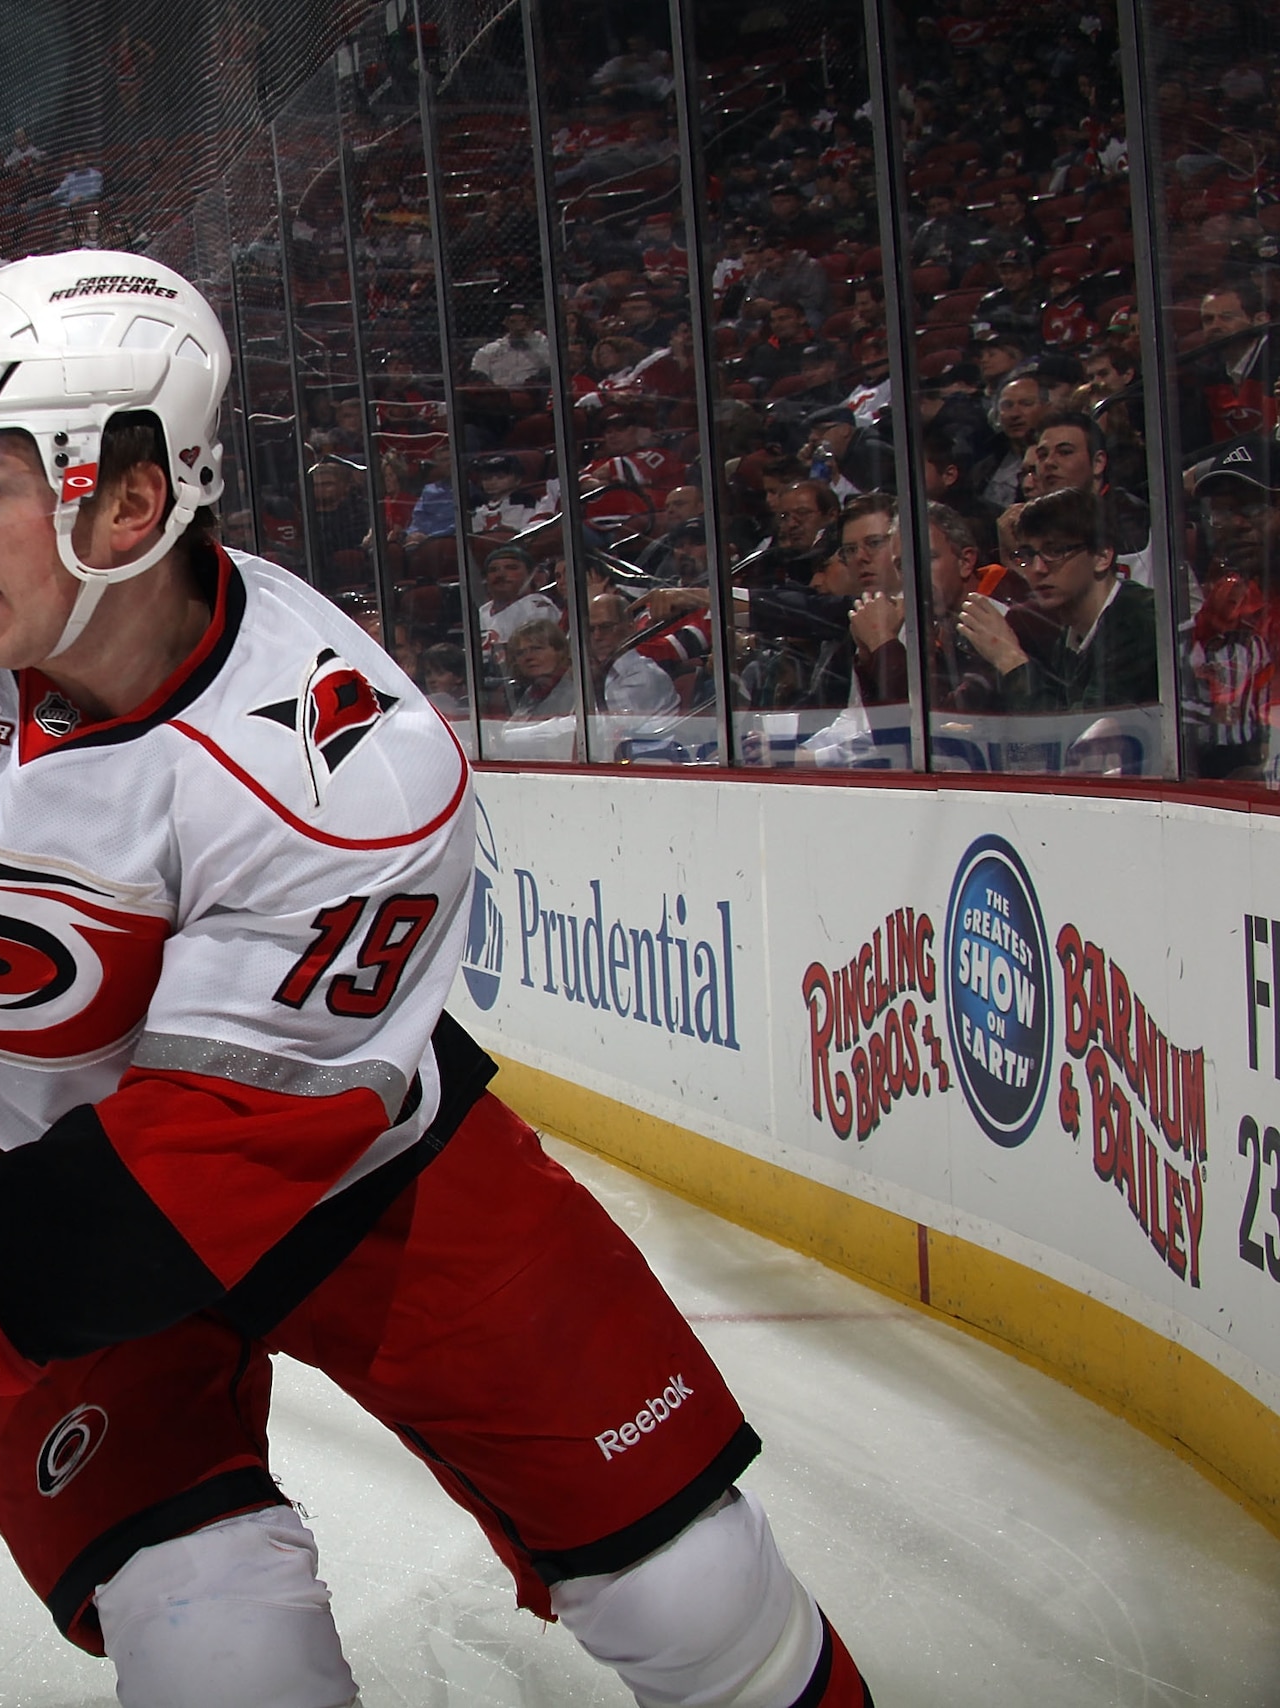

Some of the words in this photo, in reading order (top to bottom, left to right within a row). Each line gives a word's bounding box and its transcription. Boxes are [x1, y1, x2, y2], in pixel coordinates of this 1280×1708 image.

[49, 283, 179, 303] HURRICANES
[76, 275, 158, 287] CAROLINA
[963, 908, 1033, 972] GREATEST
[985, 888, 1009, 917] THE
[272, 893, 439, 1019] 19
[513, 867, 741, 1051] Prudential
[958, 938, 1036, 1029] SHOW
[802, 906, 936, 1141] RINGLING
[961, 1013, 1030, 1088] EARTH
[987, 1011, 1006, 1039] ON
[1056, 923, 1207, 1162] BARNUM
[1086, 1045, 1203, 1289] BAILEY
[595, 1373, 694, 1461] Reebok
